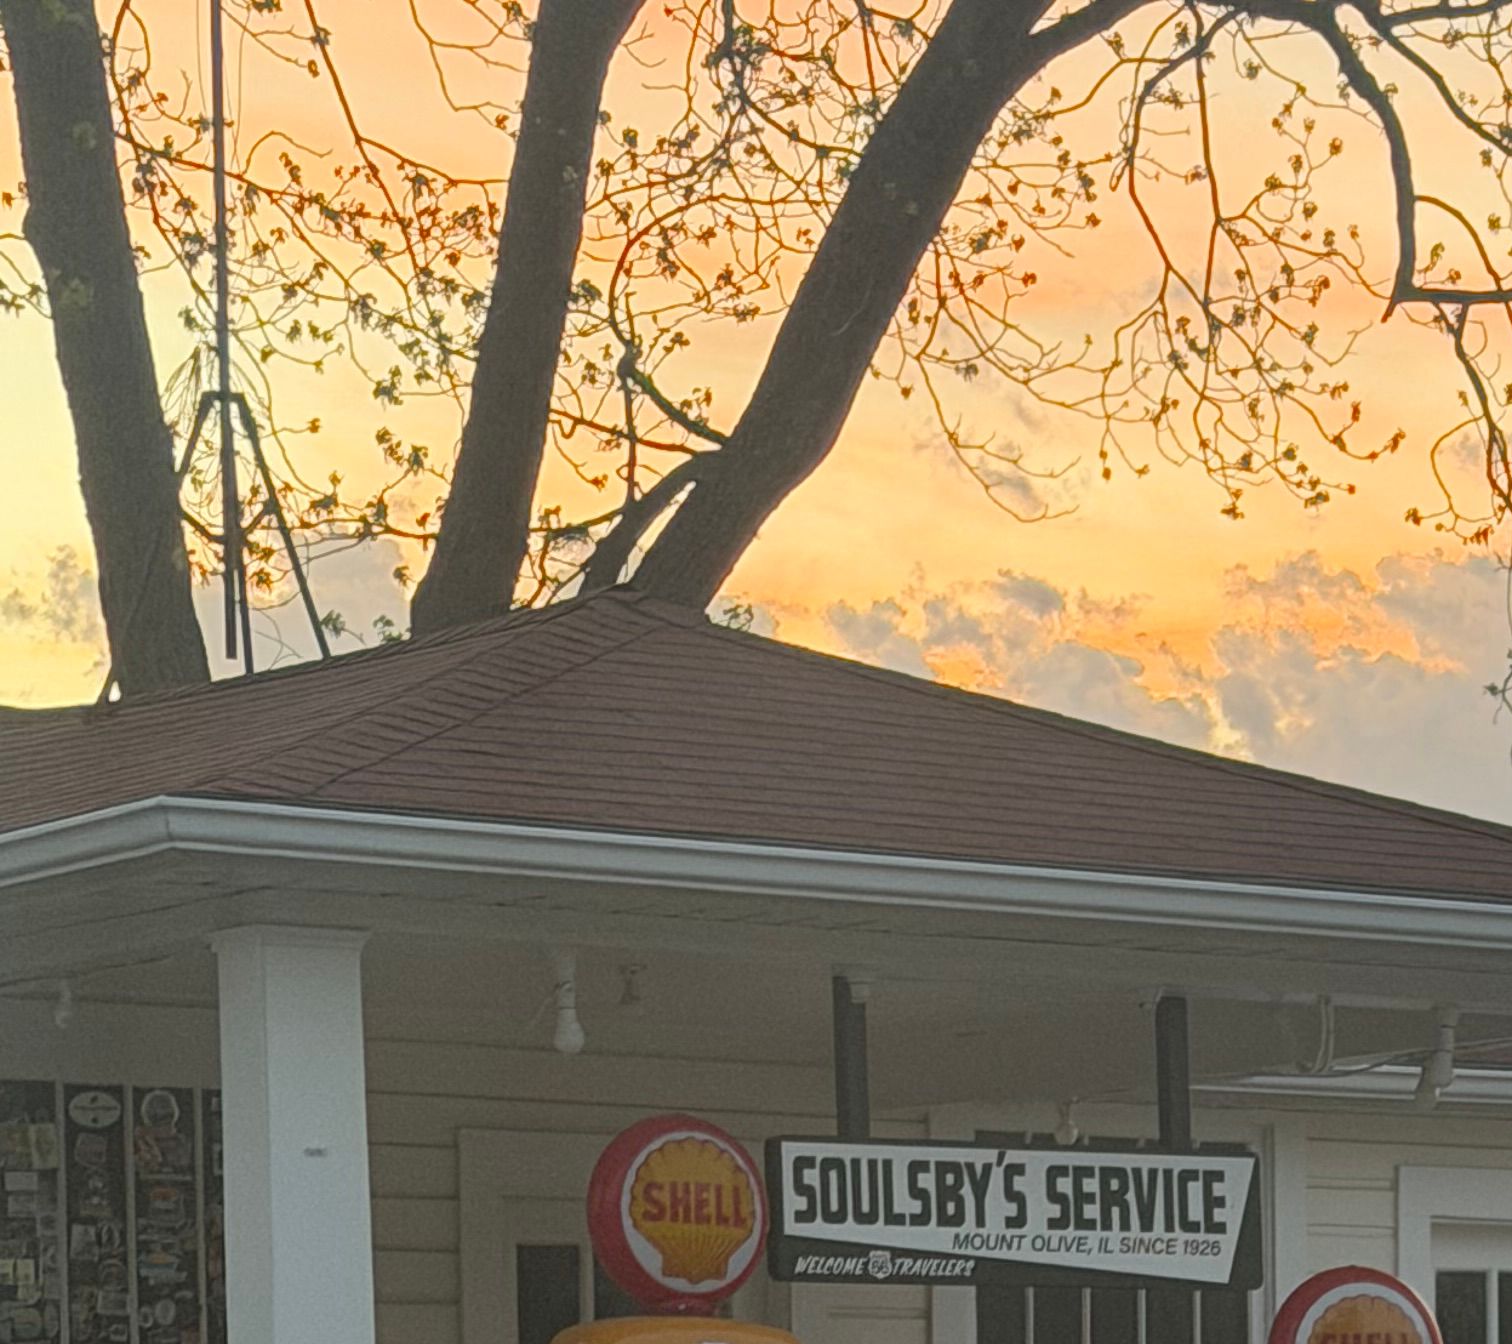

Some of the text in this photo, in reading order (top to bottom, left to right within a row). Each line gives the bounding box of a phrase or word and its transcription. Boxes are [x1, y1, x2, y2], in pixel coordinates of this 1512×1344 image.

[642, 1180, 747, 1228] SHELL
[793, 1150, 1227, 1235] SOULSBY'S SERVICE
[952, 1233, 1222, 1256] MOUNT OLIVE, IL SINCE 1926
[794, 1255, 869, 1276] WELCOME
[892, 1257, 976, 1277] TRAVELERS
